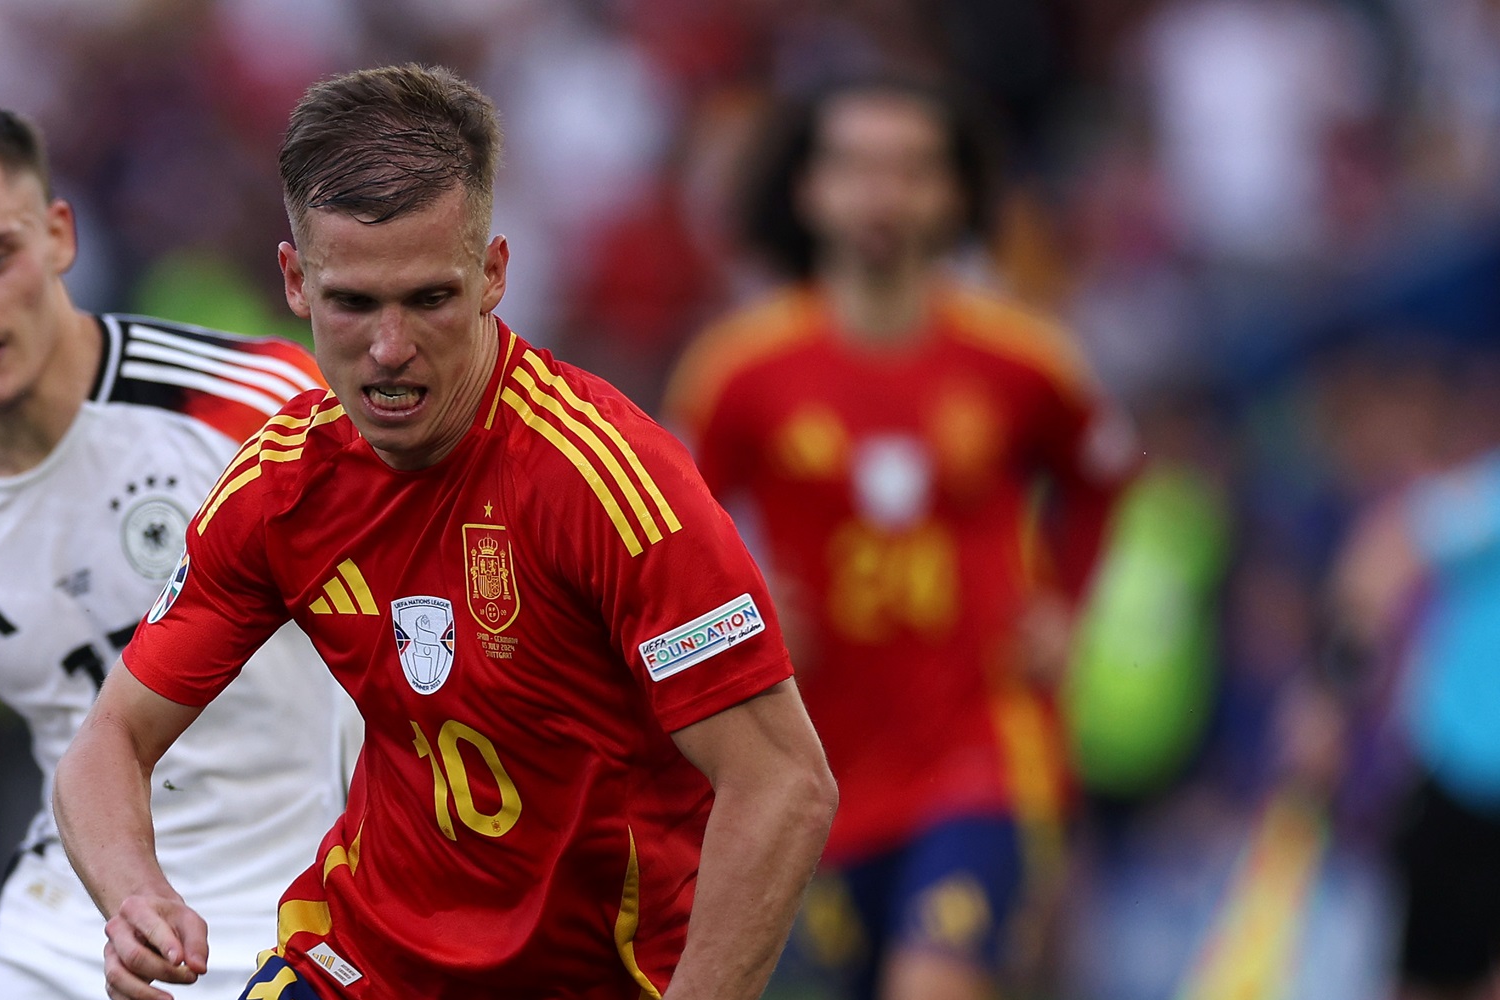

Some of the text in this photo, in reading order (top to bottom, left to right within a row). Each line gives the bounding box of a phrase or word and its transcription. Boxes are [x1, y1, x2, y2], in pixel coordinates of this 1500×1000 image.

[394, 601, 408, 609] UEFA
[431, 600, 450, 609] LEAGUE
[727, 623, 761, 646] for children
[642, 638, 667, 655] UEFA
[409, 719, 523, 841] 10
